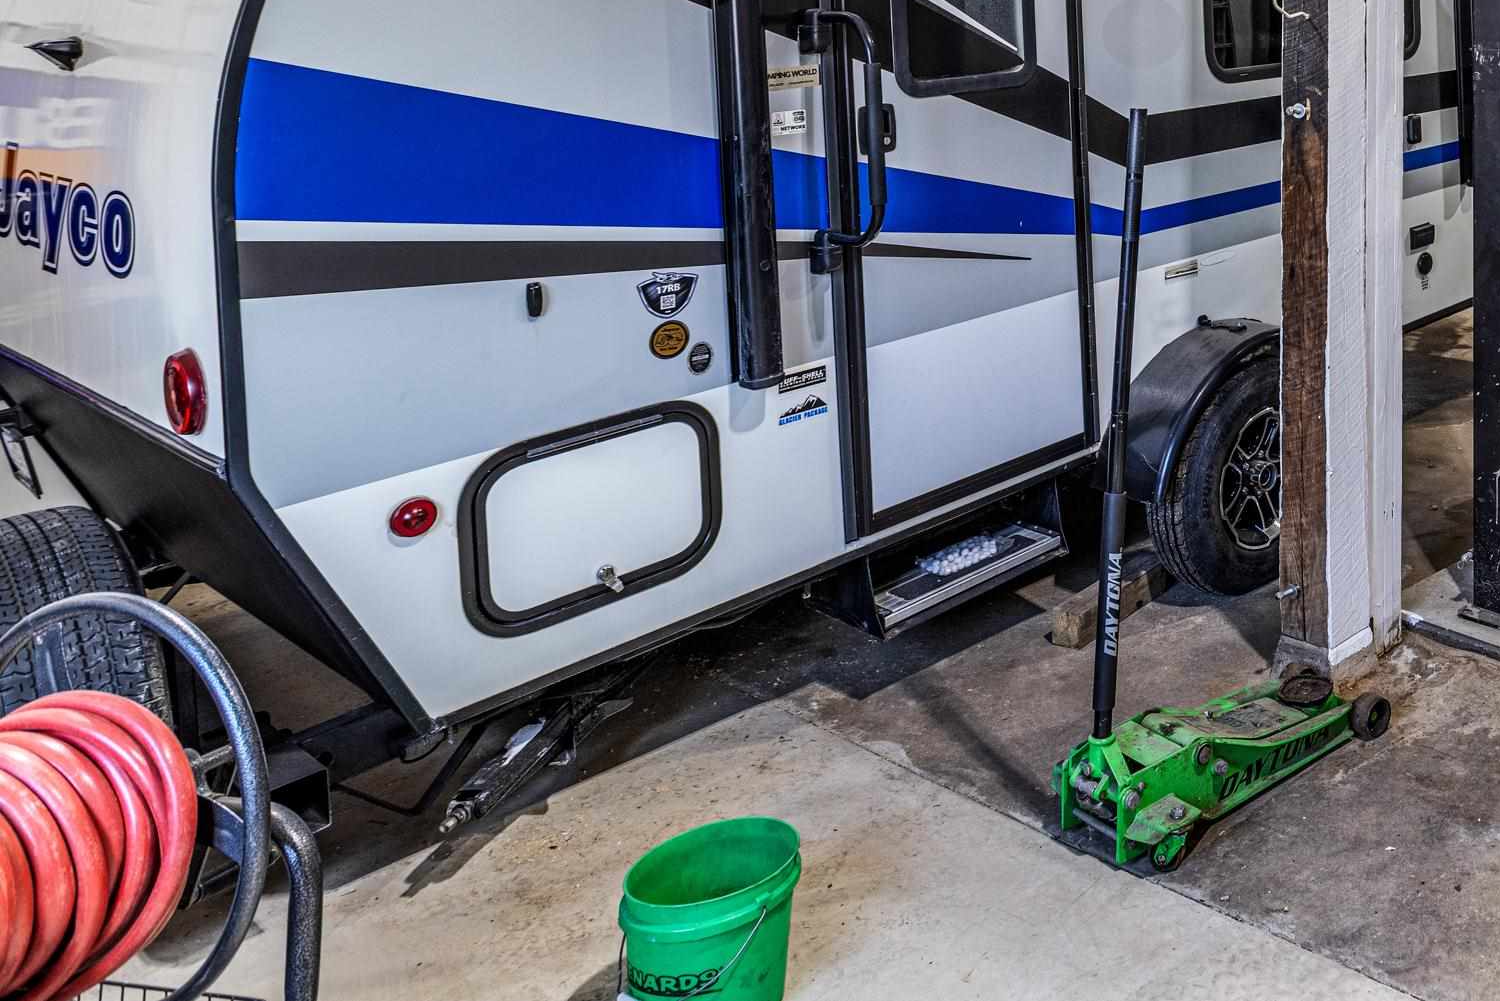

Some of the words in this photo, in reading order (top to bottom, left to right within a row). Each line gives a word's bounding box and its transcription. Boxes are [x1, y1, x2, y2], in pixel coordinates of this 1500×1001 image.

[792, 68, 817, 77] WORLD
[0, 141, 135, 279] Jayco
[656, 283, 680, 294] 17RB
[1104, 553, 1122, 656] DAYTONA
